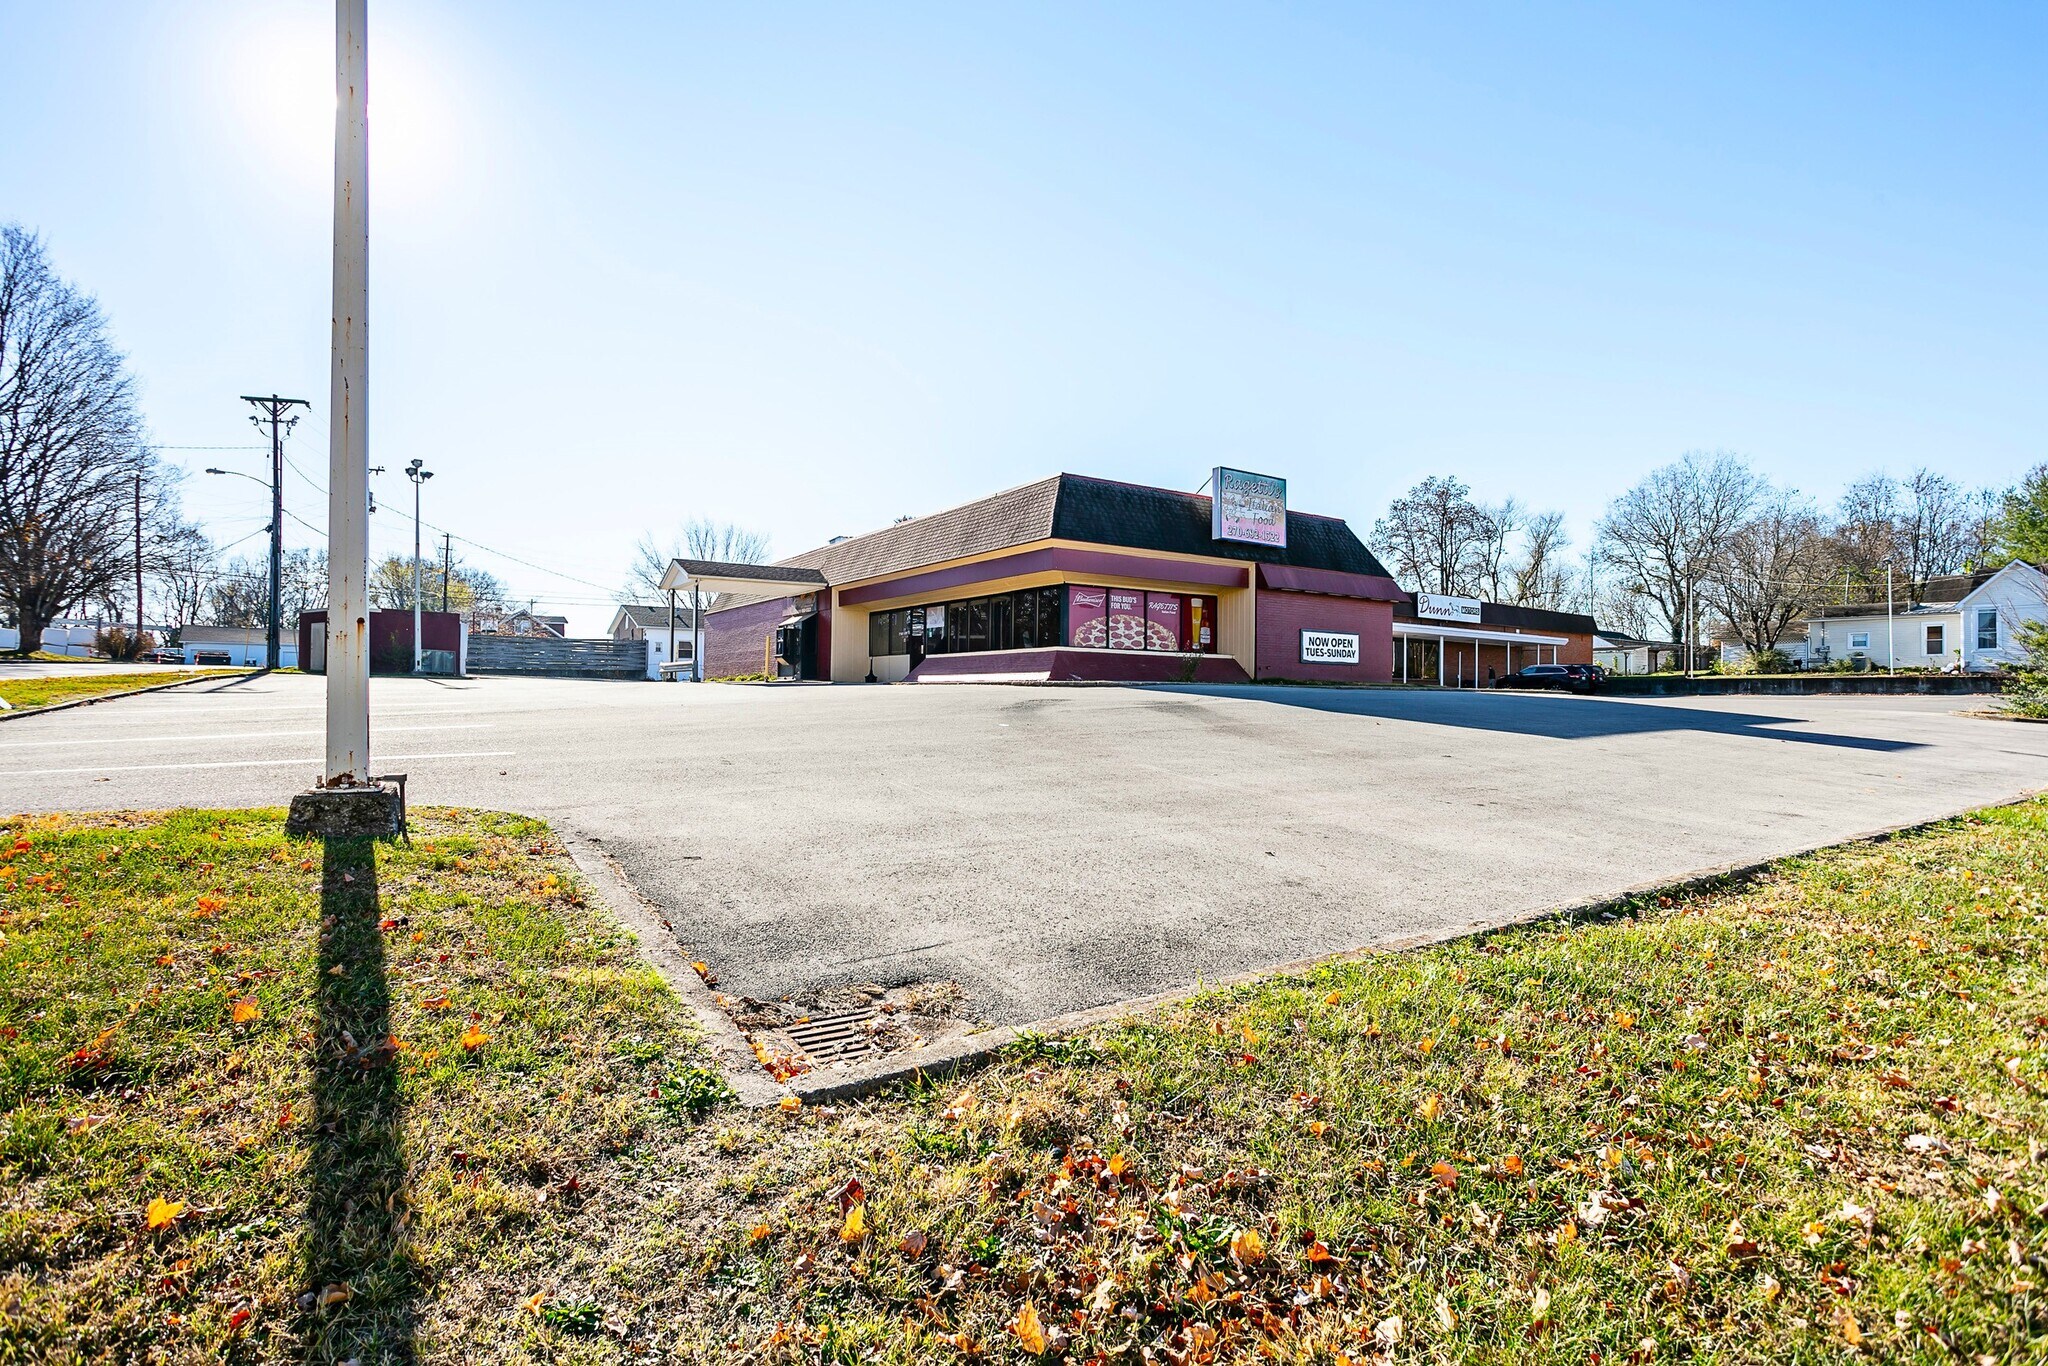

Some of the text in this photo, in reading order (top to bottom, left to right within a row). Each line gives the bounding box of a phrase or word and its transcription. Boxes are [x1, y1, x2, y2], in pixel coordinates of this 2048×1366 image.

[1247, 498, 1282, 513] Italian
[1252, 512, 1276, 526] Food
[1110, 595, 1137, 604] THIS BUD'S
[1419, 595, 1451, 617] Dunn
[1462, 607, 1480, 615] MOTORS
[1308, 636, 1353, 648] NOW OPEN
[1305, 647, 1356, 659] TUES-SUNDAY
